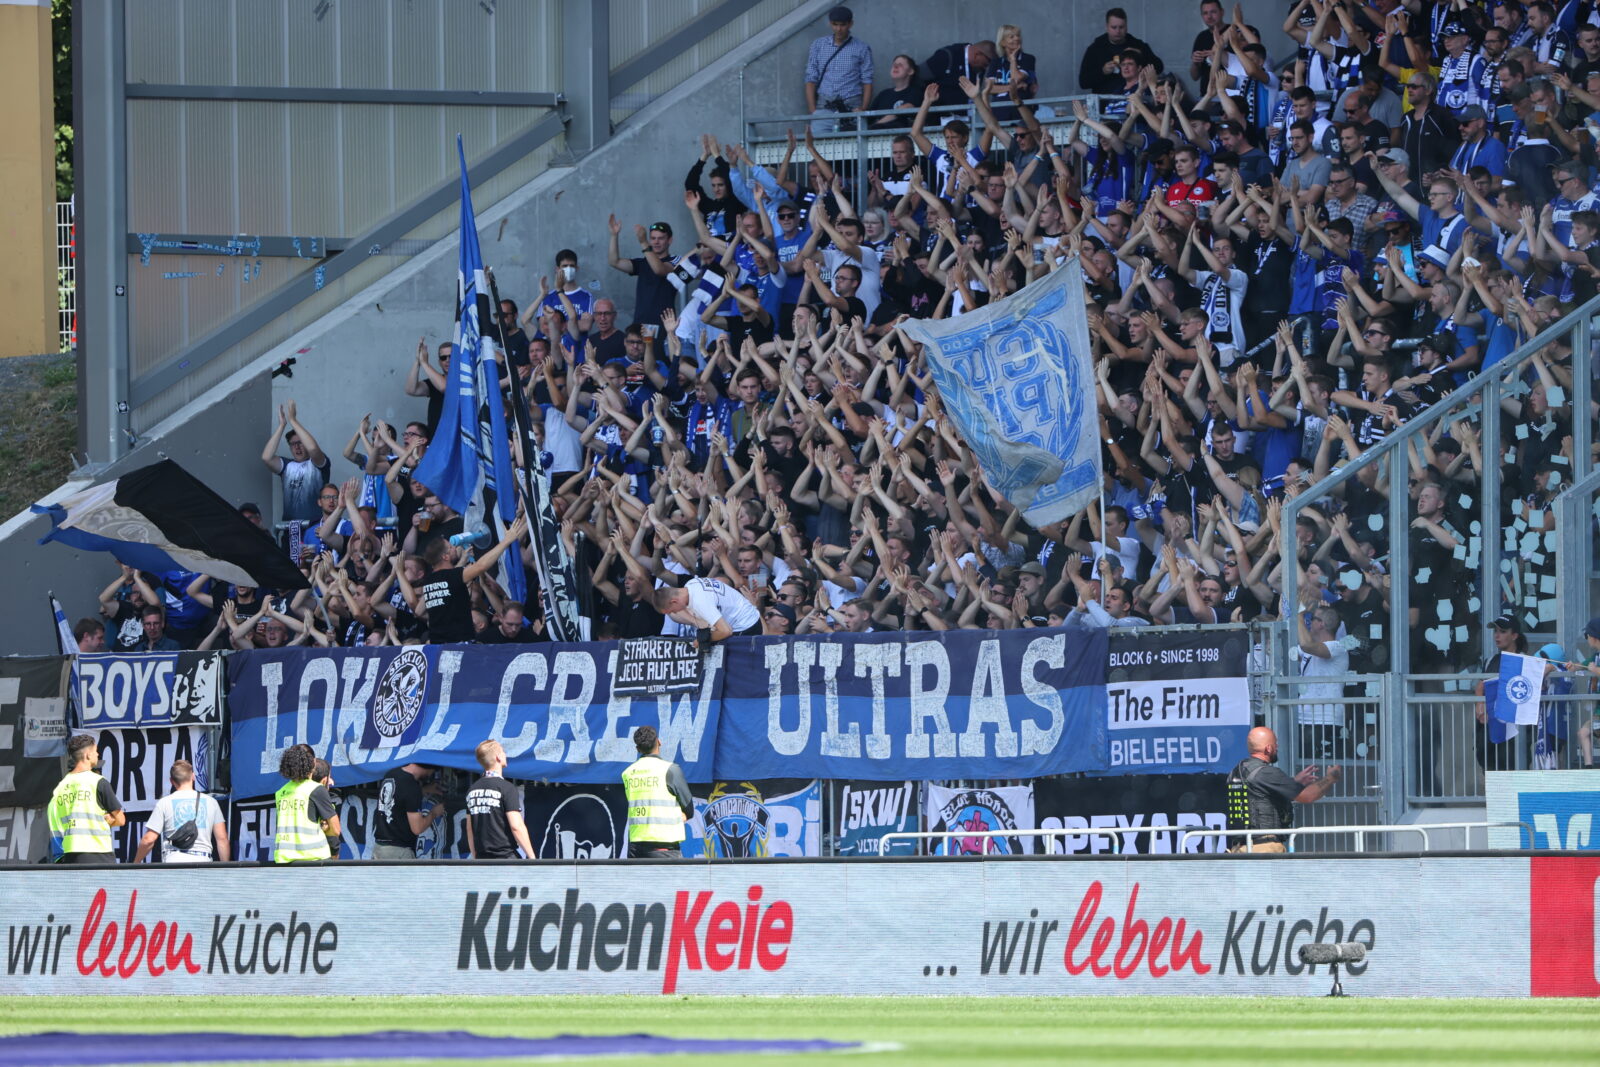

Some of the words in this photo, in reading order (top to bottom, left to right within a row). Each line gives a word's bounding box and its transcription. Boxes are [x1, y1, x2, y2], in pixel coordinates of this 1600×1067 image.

[389, 651, 426, 676] SEKTION
[624, 638, 672, 660] STÄRKER
[1109, 651, 1144, 667] BLOCK
[1146, 651, 1152, 664] 6
[1160, 649, 1193, 664] SINCE
[1195, 648, 1219, 662] 1998
[647, 659, 699, 680] AUFLAGE
[80, 660, 174, 723] BOYS
[488, 645, 724, 764] CREW
[764, 633, 1066, 759] ULTRAS
[1109, 688, 1154, 722] The
[1162, 687, 1220, 720] Firm
[1110, 737, 1221, 766] BIELEFELD
[856, 838, 890, 853] ULTRS
[7, 913, 71, 975] wir
[76, 888, 201, 979] leben
[207, 910, 338, 975] Küche
[980, 908, 1058, 976] wir
[1064, 880, 1212, 980] leben
[1218, 904, 1376, 976] Küche
